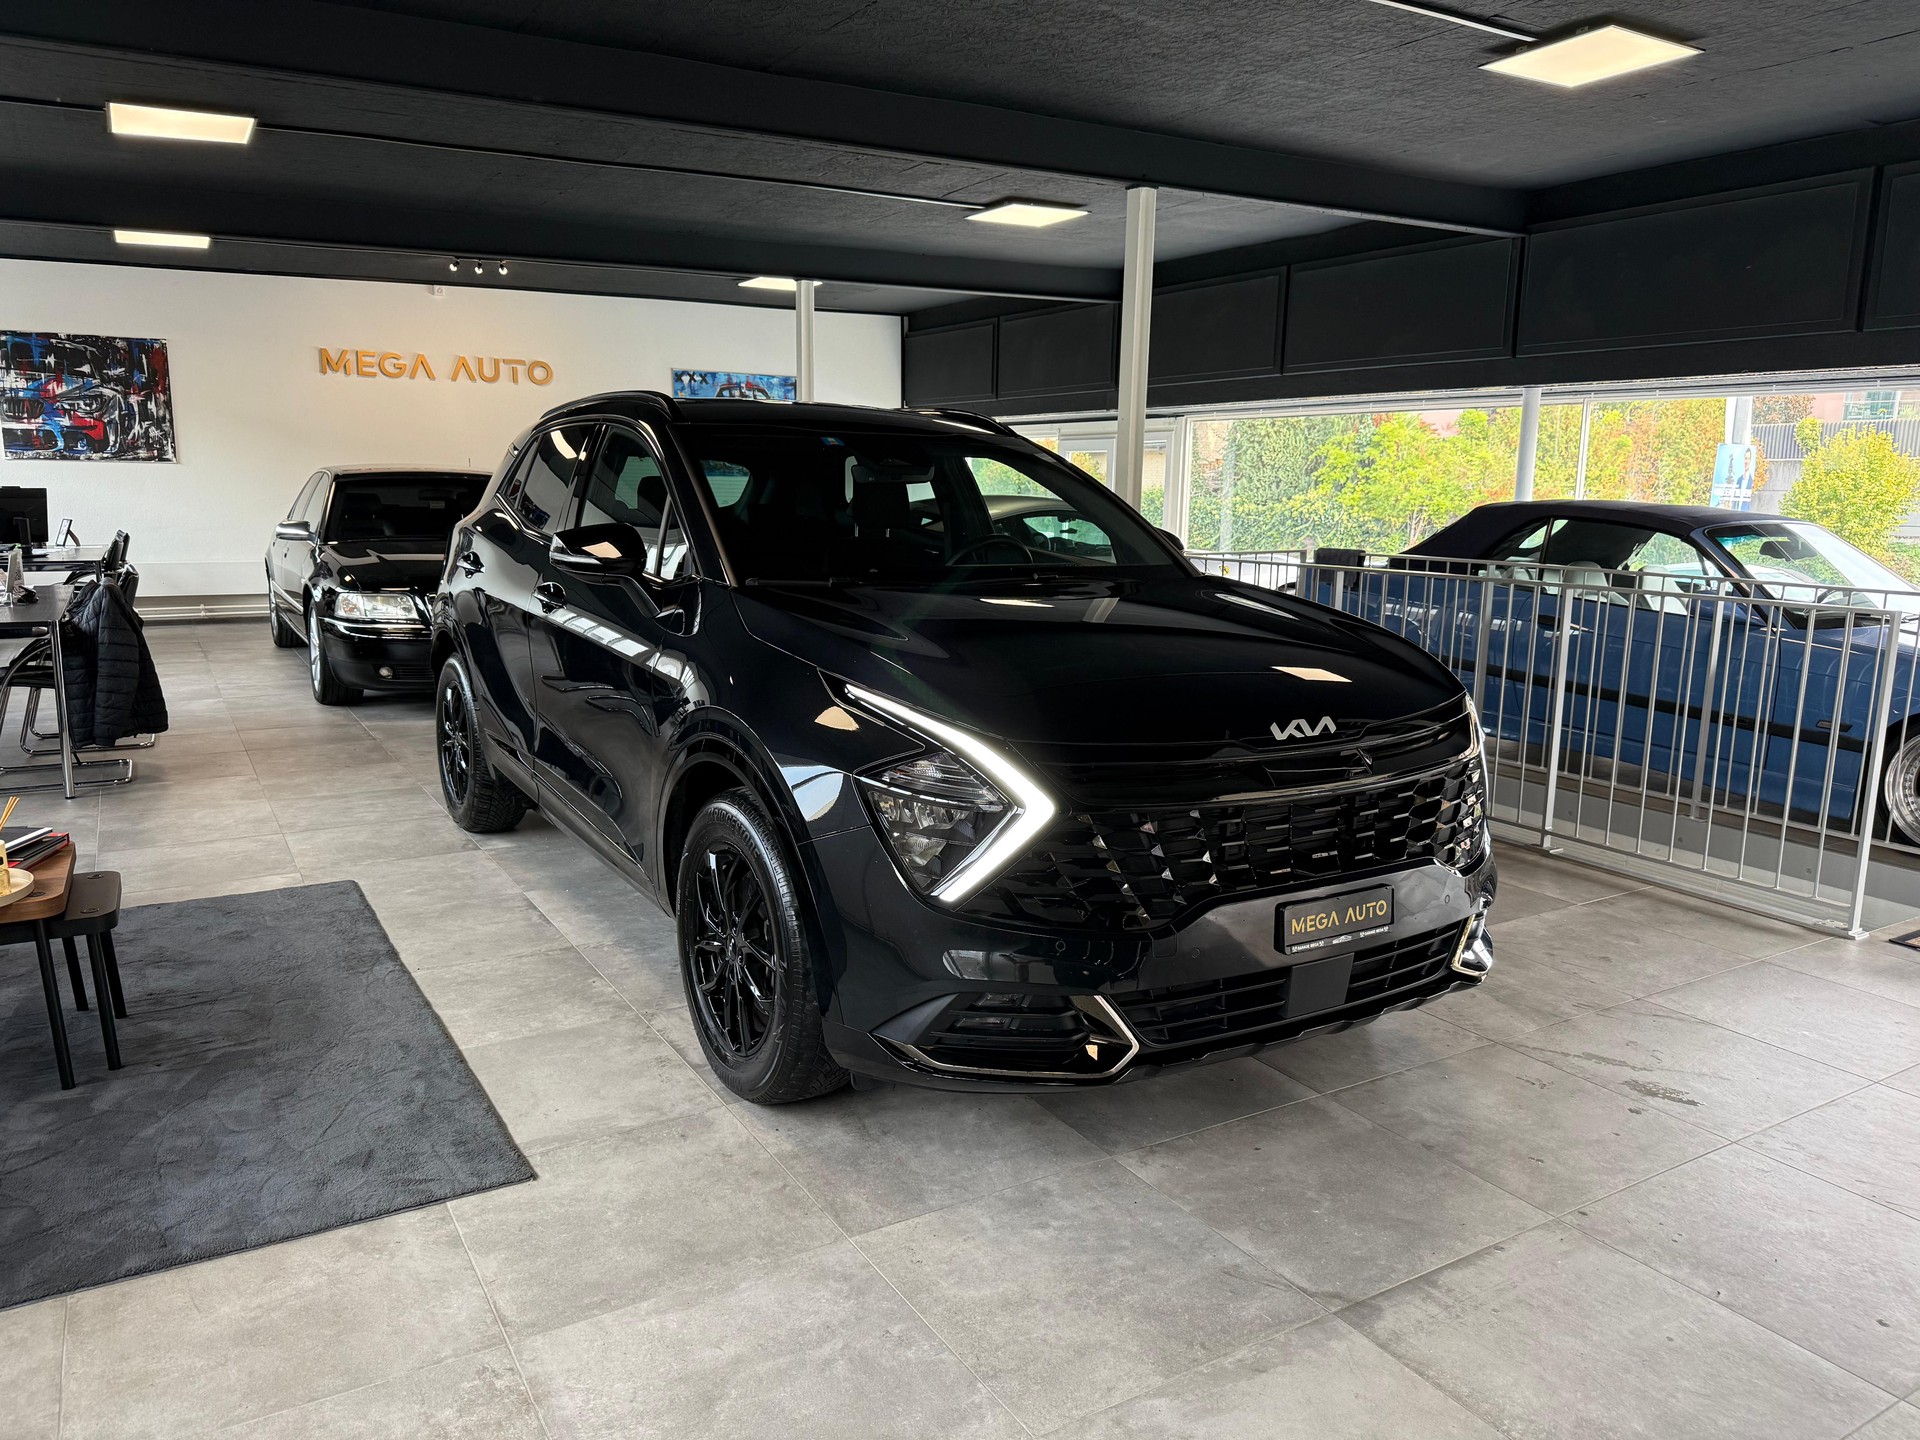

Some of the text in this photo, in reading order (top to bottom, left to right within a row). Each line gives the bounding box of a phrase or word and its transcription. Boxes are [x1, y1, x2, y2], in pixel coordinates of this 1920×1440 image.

[319, 347, 554, 386] MEGA AUTO
[1270, 716, 1337, 741] KIA
[1290, 899, 1387, 935] MEGA AUTO
